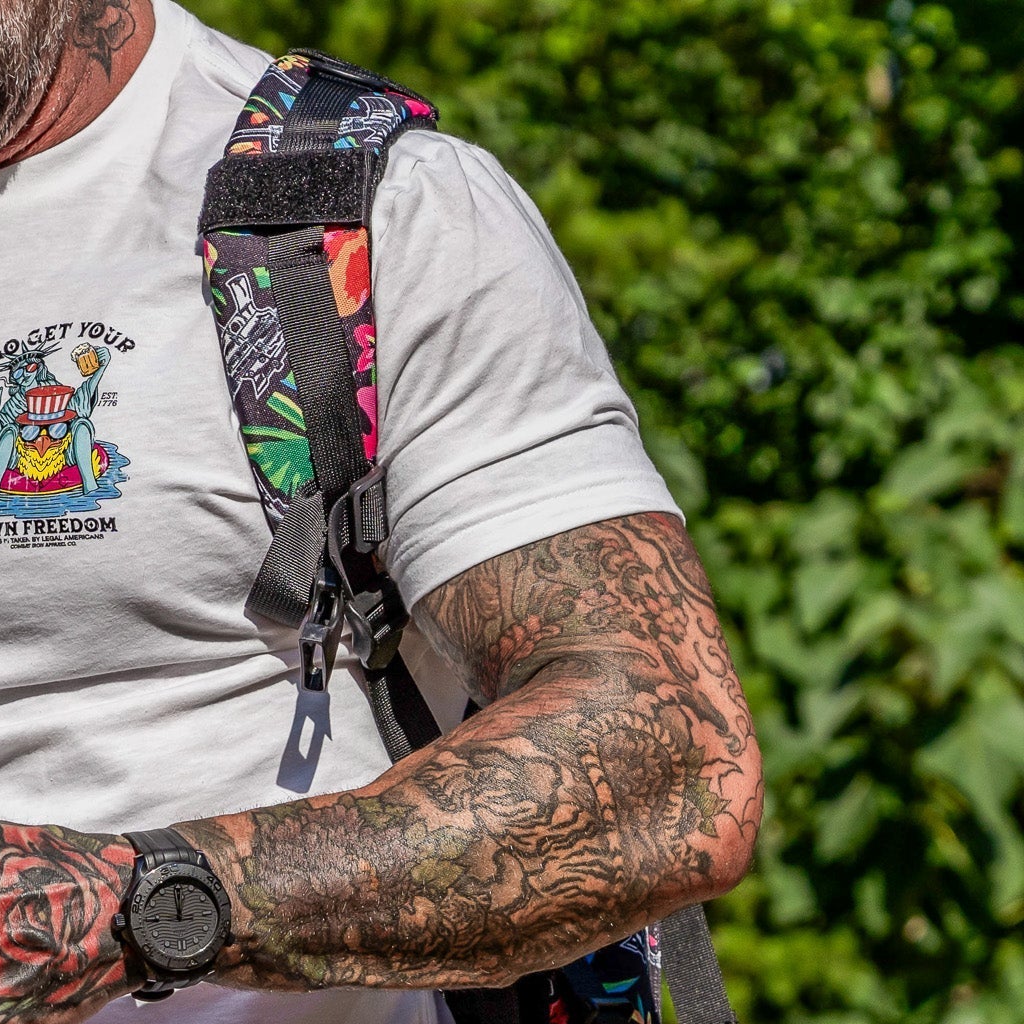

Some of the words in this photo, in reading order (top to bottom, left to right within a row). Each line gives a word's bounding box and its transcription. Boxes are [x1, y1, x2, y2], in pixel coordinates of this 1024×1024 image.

[27, 322, 74, 346] GET
[78, 321, 136, 354] YOUR
[97, 400, 118, 408] 1776
[23, 517, 118, 535] FREEDOM
[63, 533, 105, 541] AMERICANS
